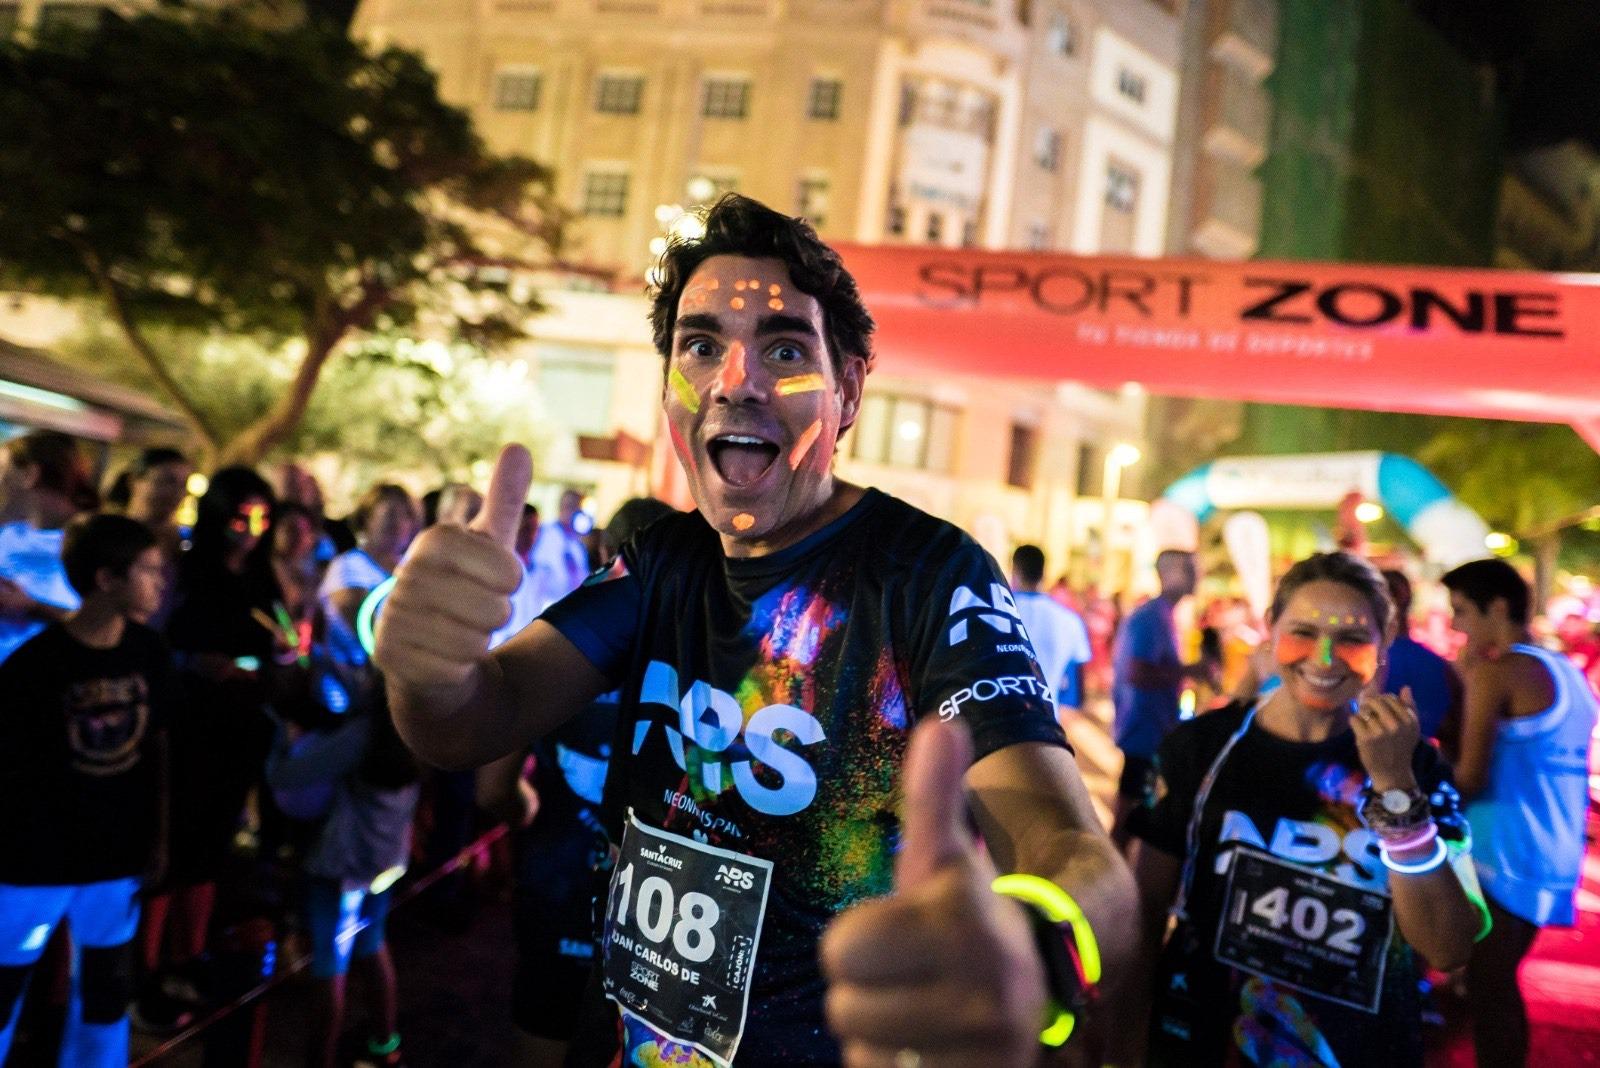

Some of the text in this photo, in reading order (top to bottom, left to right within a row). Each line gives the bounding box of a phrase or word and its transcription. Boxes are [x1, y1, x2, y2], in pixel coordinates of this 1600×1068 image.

[918, 263, 1565, 340] SPORT ZONE
[617, 862, 720, 963] 108
[1252, 886, 1367, 955] 402
[629, 969, 660, 992] ZONE
[634, 943, 679, 976] CARLOS
[681, 968, 700, 986] DE
